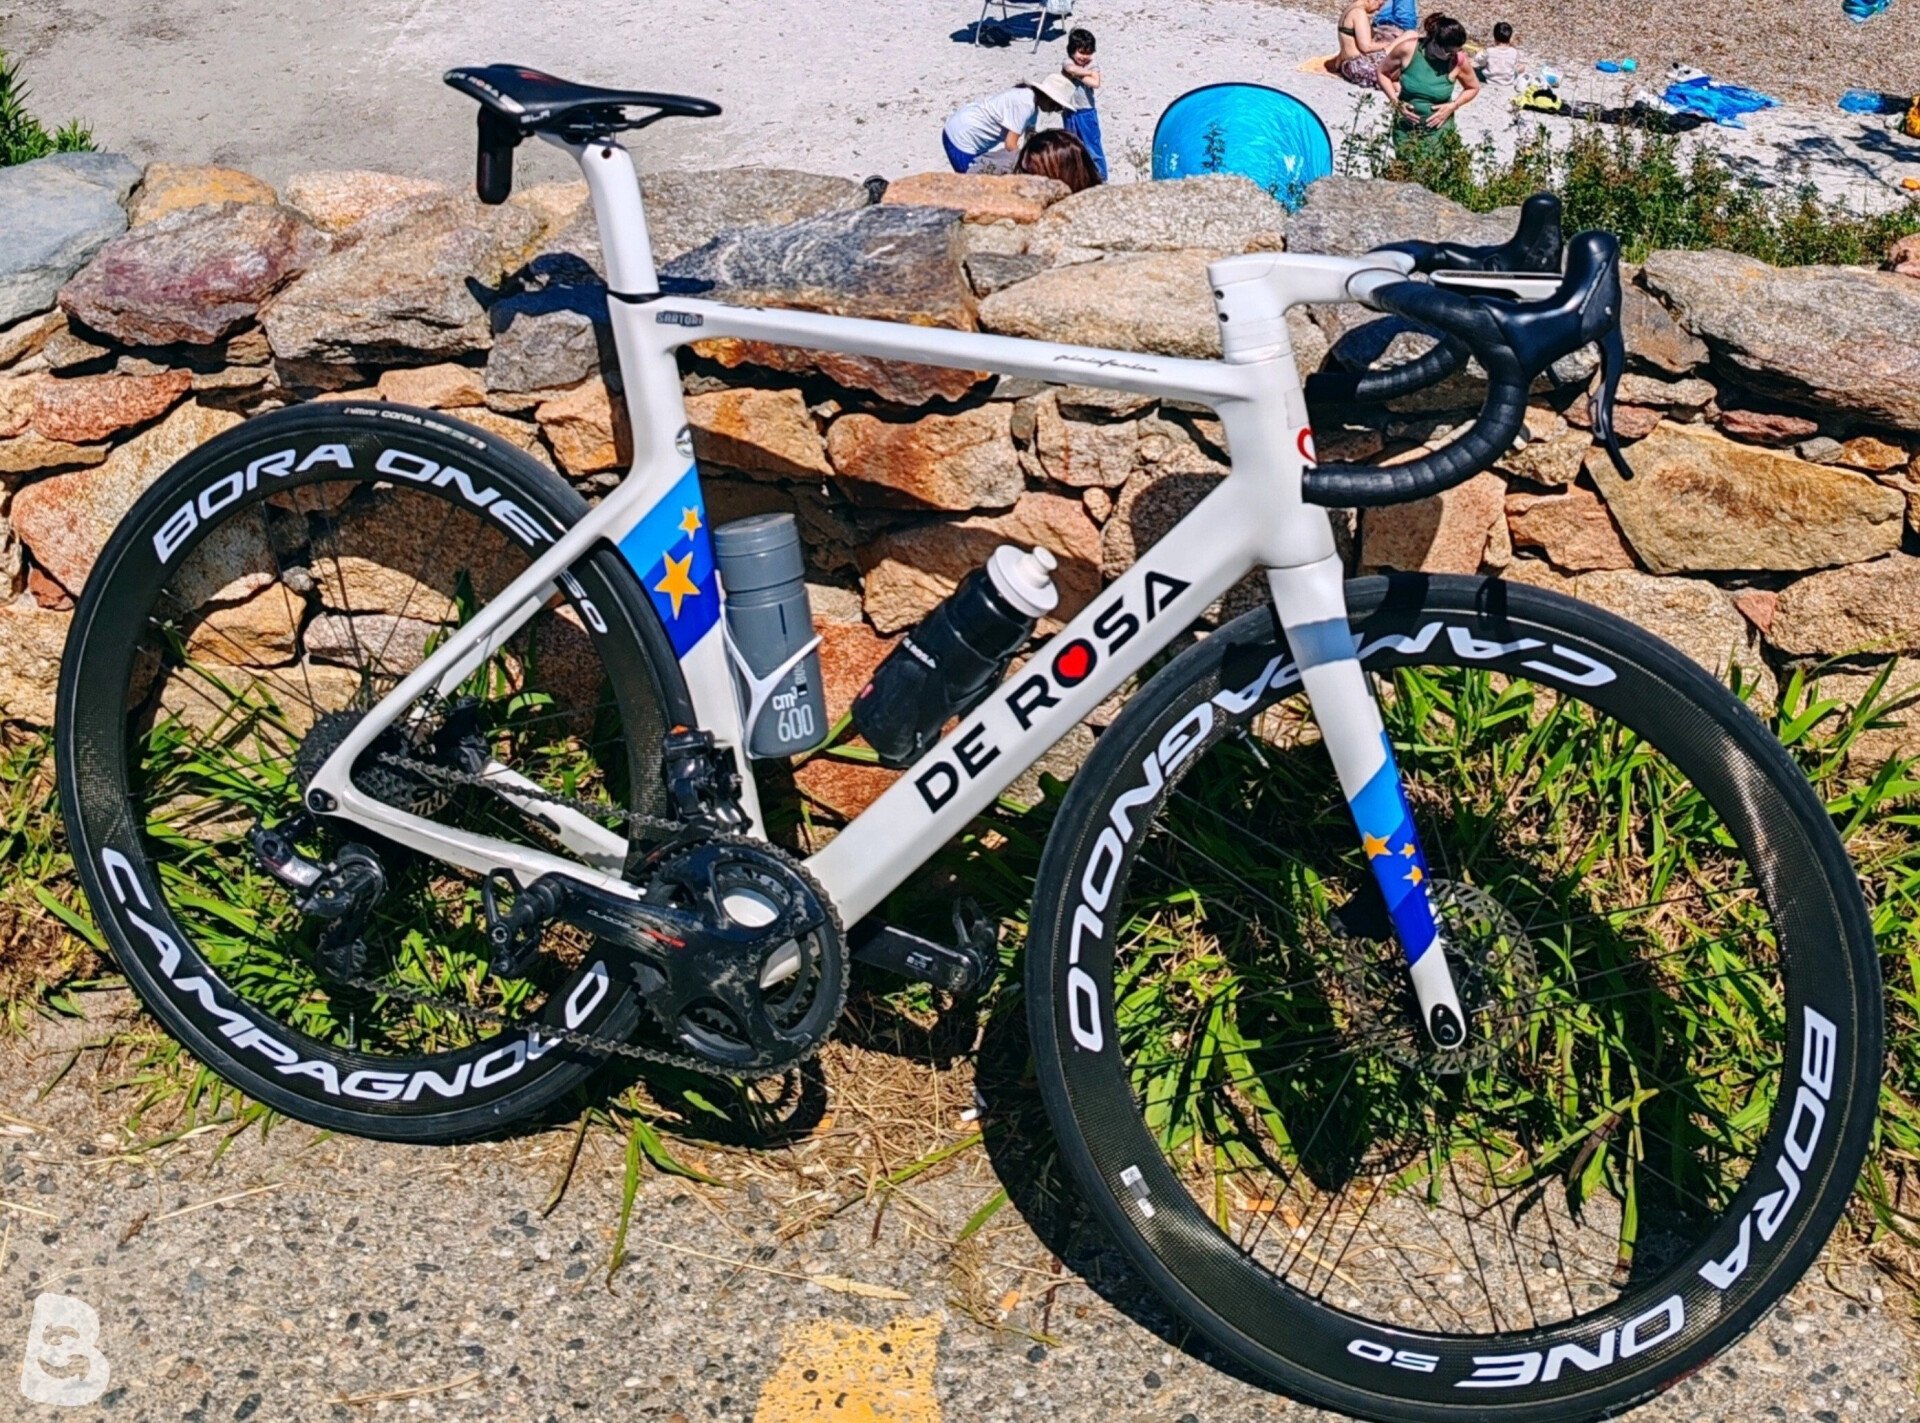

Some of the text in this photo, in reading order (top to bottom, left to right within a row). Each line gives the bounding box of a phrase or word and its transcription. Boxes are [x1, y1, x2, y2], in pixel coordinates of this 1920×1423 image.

[381, 410, 422, 425] CORSA
[153, 443, 353, 565] BORA
[376, 448, 556, 547] ONE
[778, 704, 815, 742] 600
[913, 570, 1190, 815] DE ROSA
[1347, 1005, 1837, 1388] BORA ONE 50
